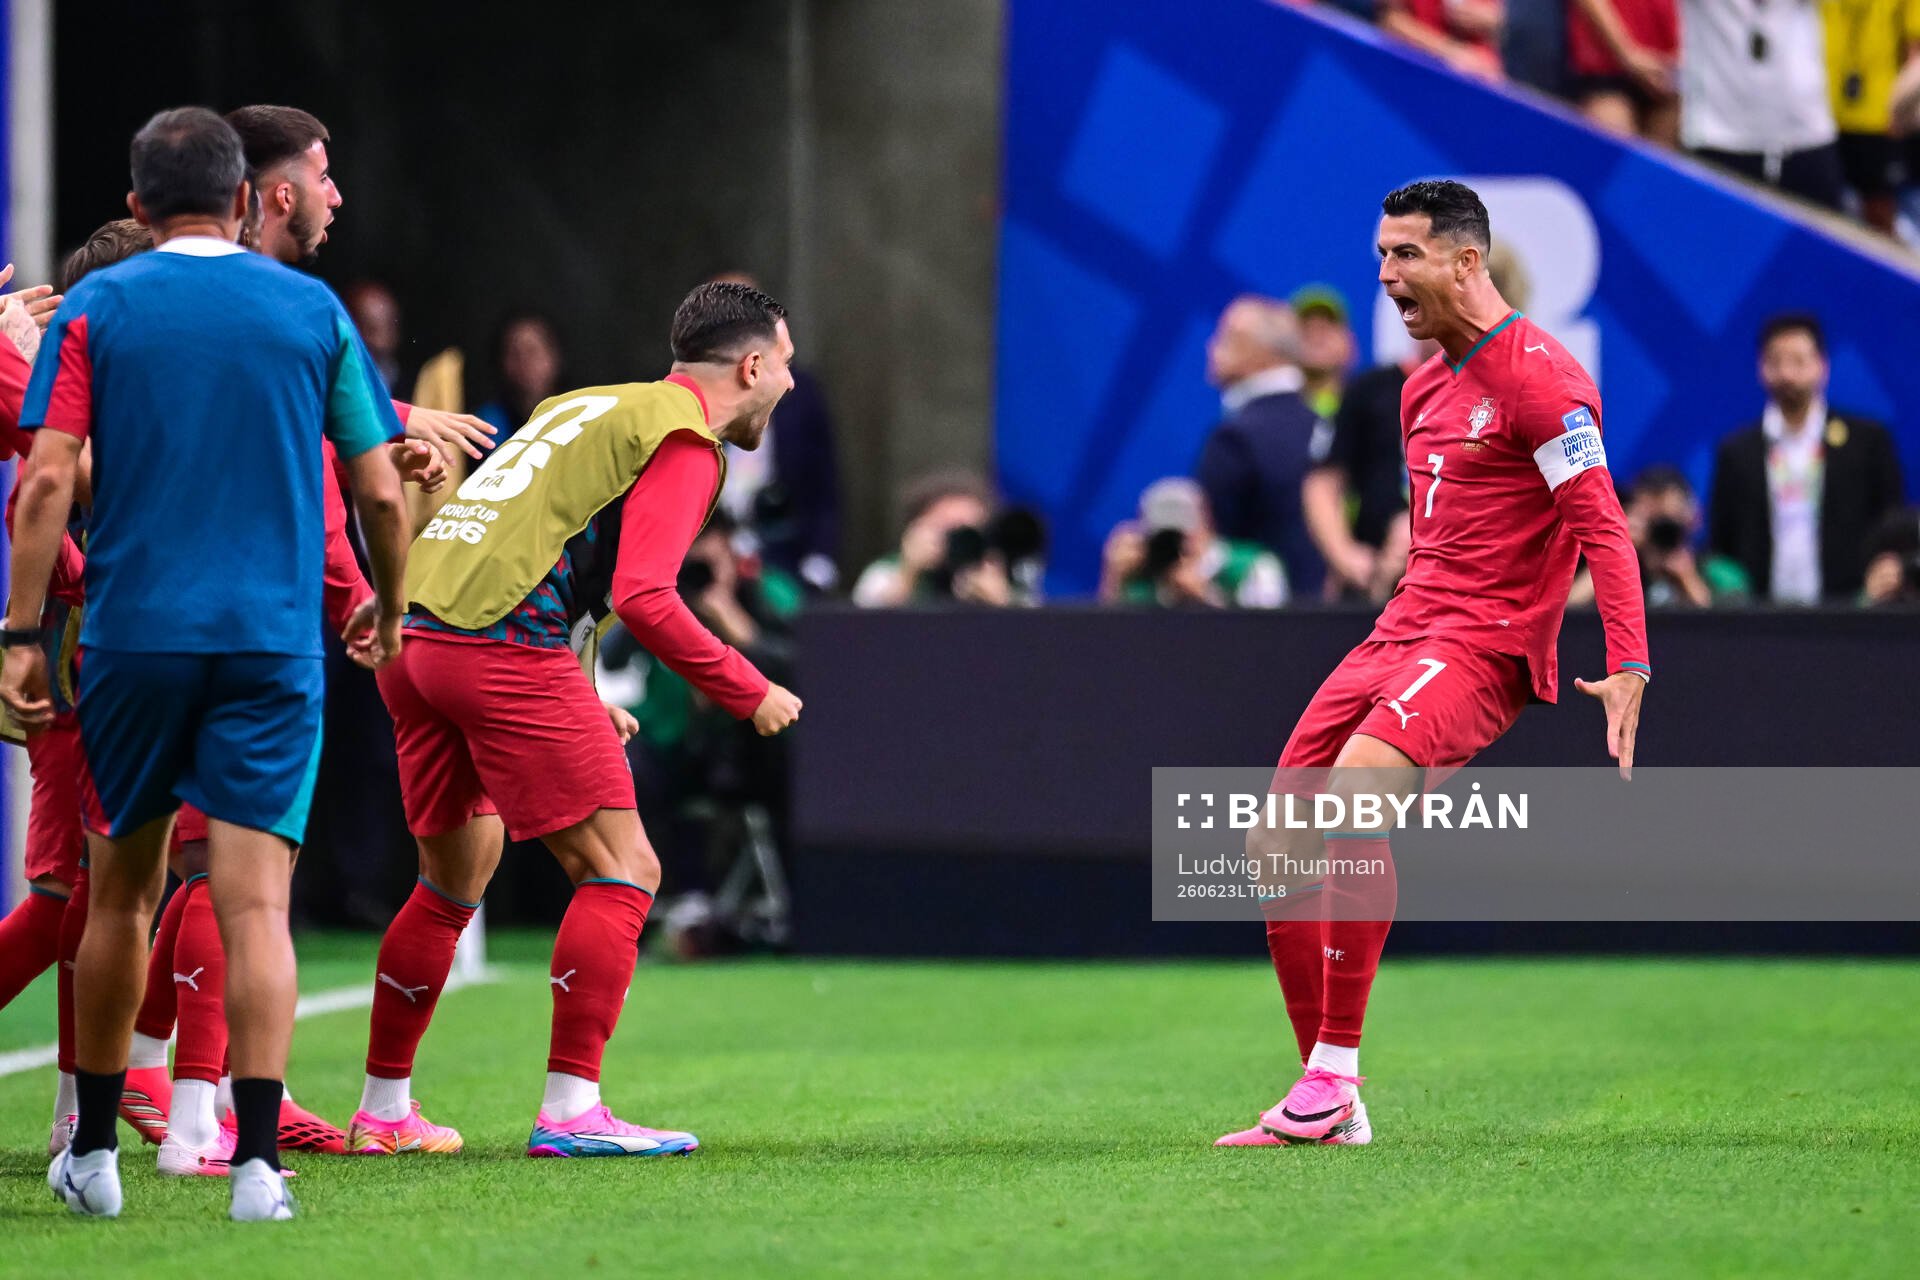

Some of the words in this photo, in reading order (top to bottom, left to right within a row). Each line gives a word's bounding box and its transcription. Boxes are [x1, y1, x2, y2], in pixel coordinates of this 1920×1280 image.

[1564, 437, 1600, 458] UNITES
[1424, 453, 1445, 518] 7
[1397, 658, 1447, 702] 7
